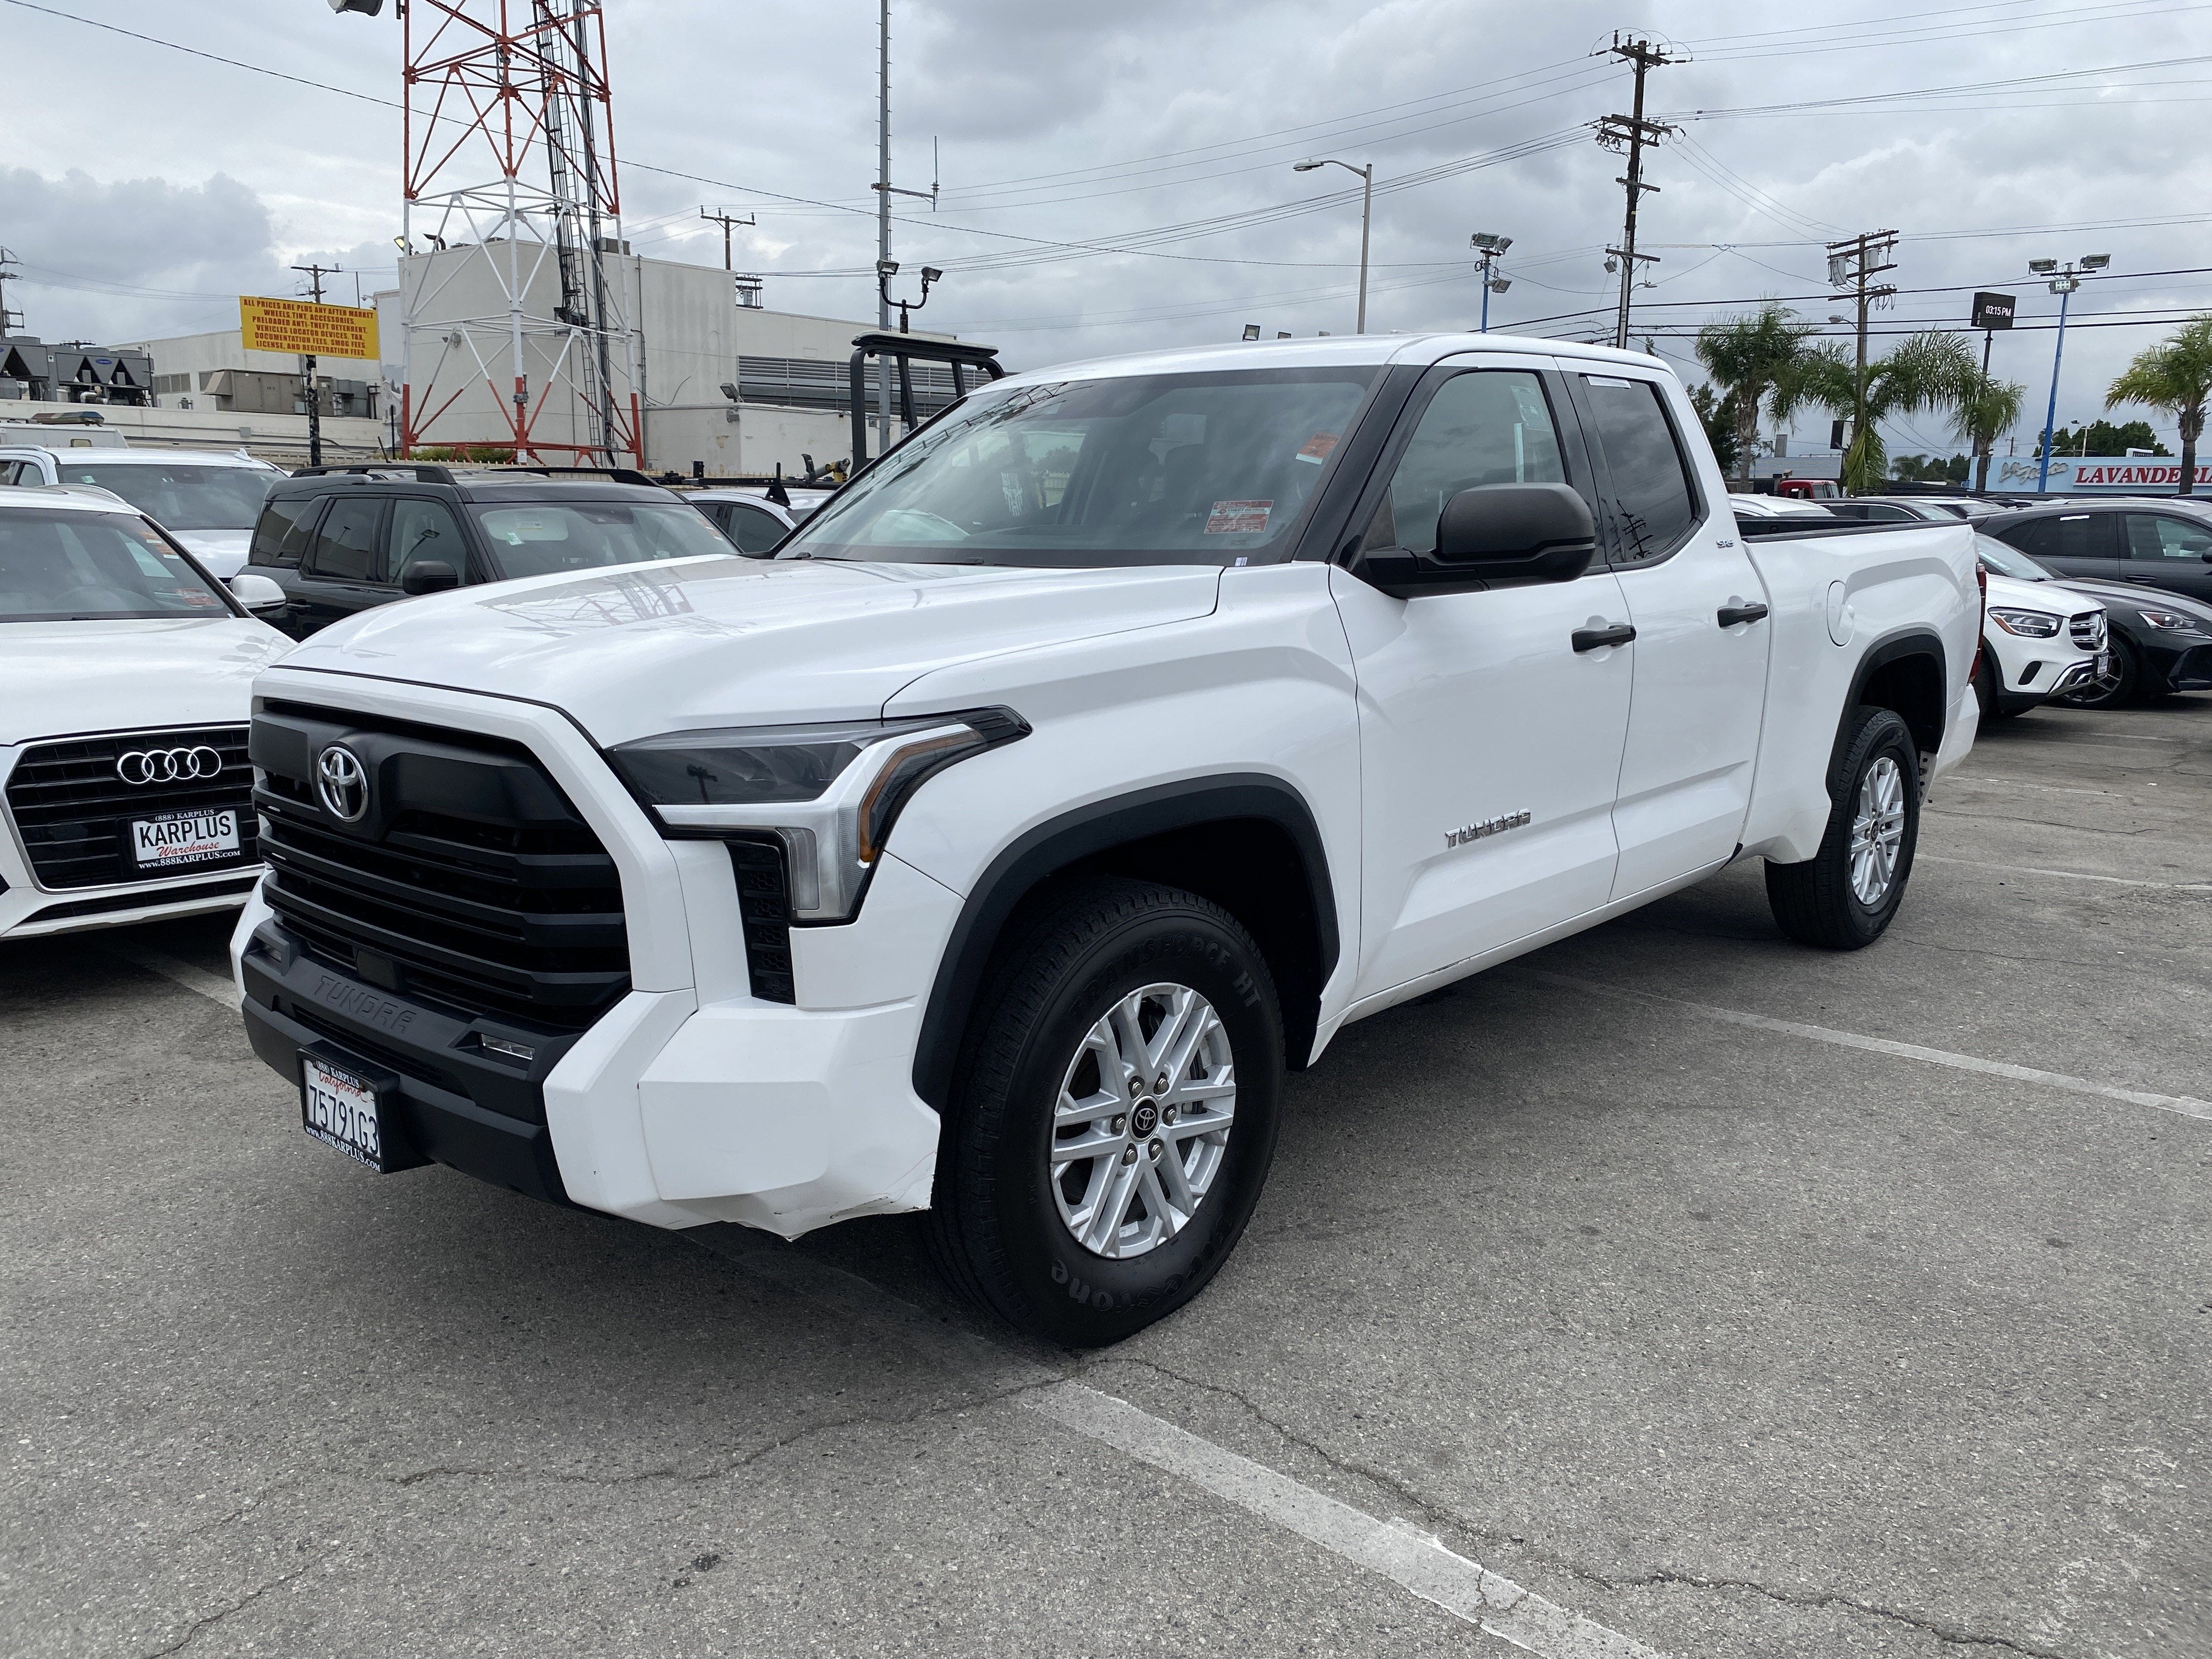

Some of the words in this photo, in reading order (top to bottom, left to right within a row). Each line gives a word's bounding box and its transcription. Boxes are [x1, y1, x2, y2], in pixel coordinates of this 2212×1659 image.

[257, 300, 281, 309] PRICES
[297, 304, 313, 313] PLUS
[349, 311, 374, 319] MARKET
[1985, 305, 2001, 315] 03:15
[2001, 307, 2012, 317] PM
[252, 316, 290, 326] PRELOADED
[292, 320, 329, 330] ANTI-THEFT
[256, 324, 288, 334] VEHICLES
[290, 328, 319, 336] LOCATOR
[255, 332, 311, 343] DOCUMENTATION
[256, 340, 285, 349] LICENSE,
[302, 345, 349, 354] REGISTRATION
[2075, 467, 2212, 483] LAVANDEI
[155, 814, 174, 822] (888)
[177, 809, 215, 820] KARPLUS
[139, 815, 232, 848] KARPLUS
[1444, 808, 1531, 848] TUNDRA
[156, 840, 220, 857] Warehouse
[1232, 968, 1262, 1007] HT
[313, 974, 417, 1035] TUNDRA
[330, 1066, 359, 1088] KARPLUS
[319, 1071, 368, 1103] California
[309, 1084, 379, 1155] 75791G3
